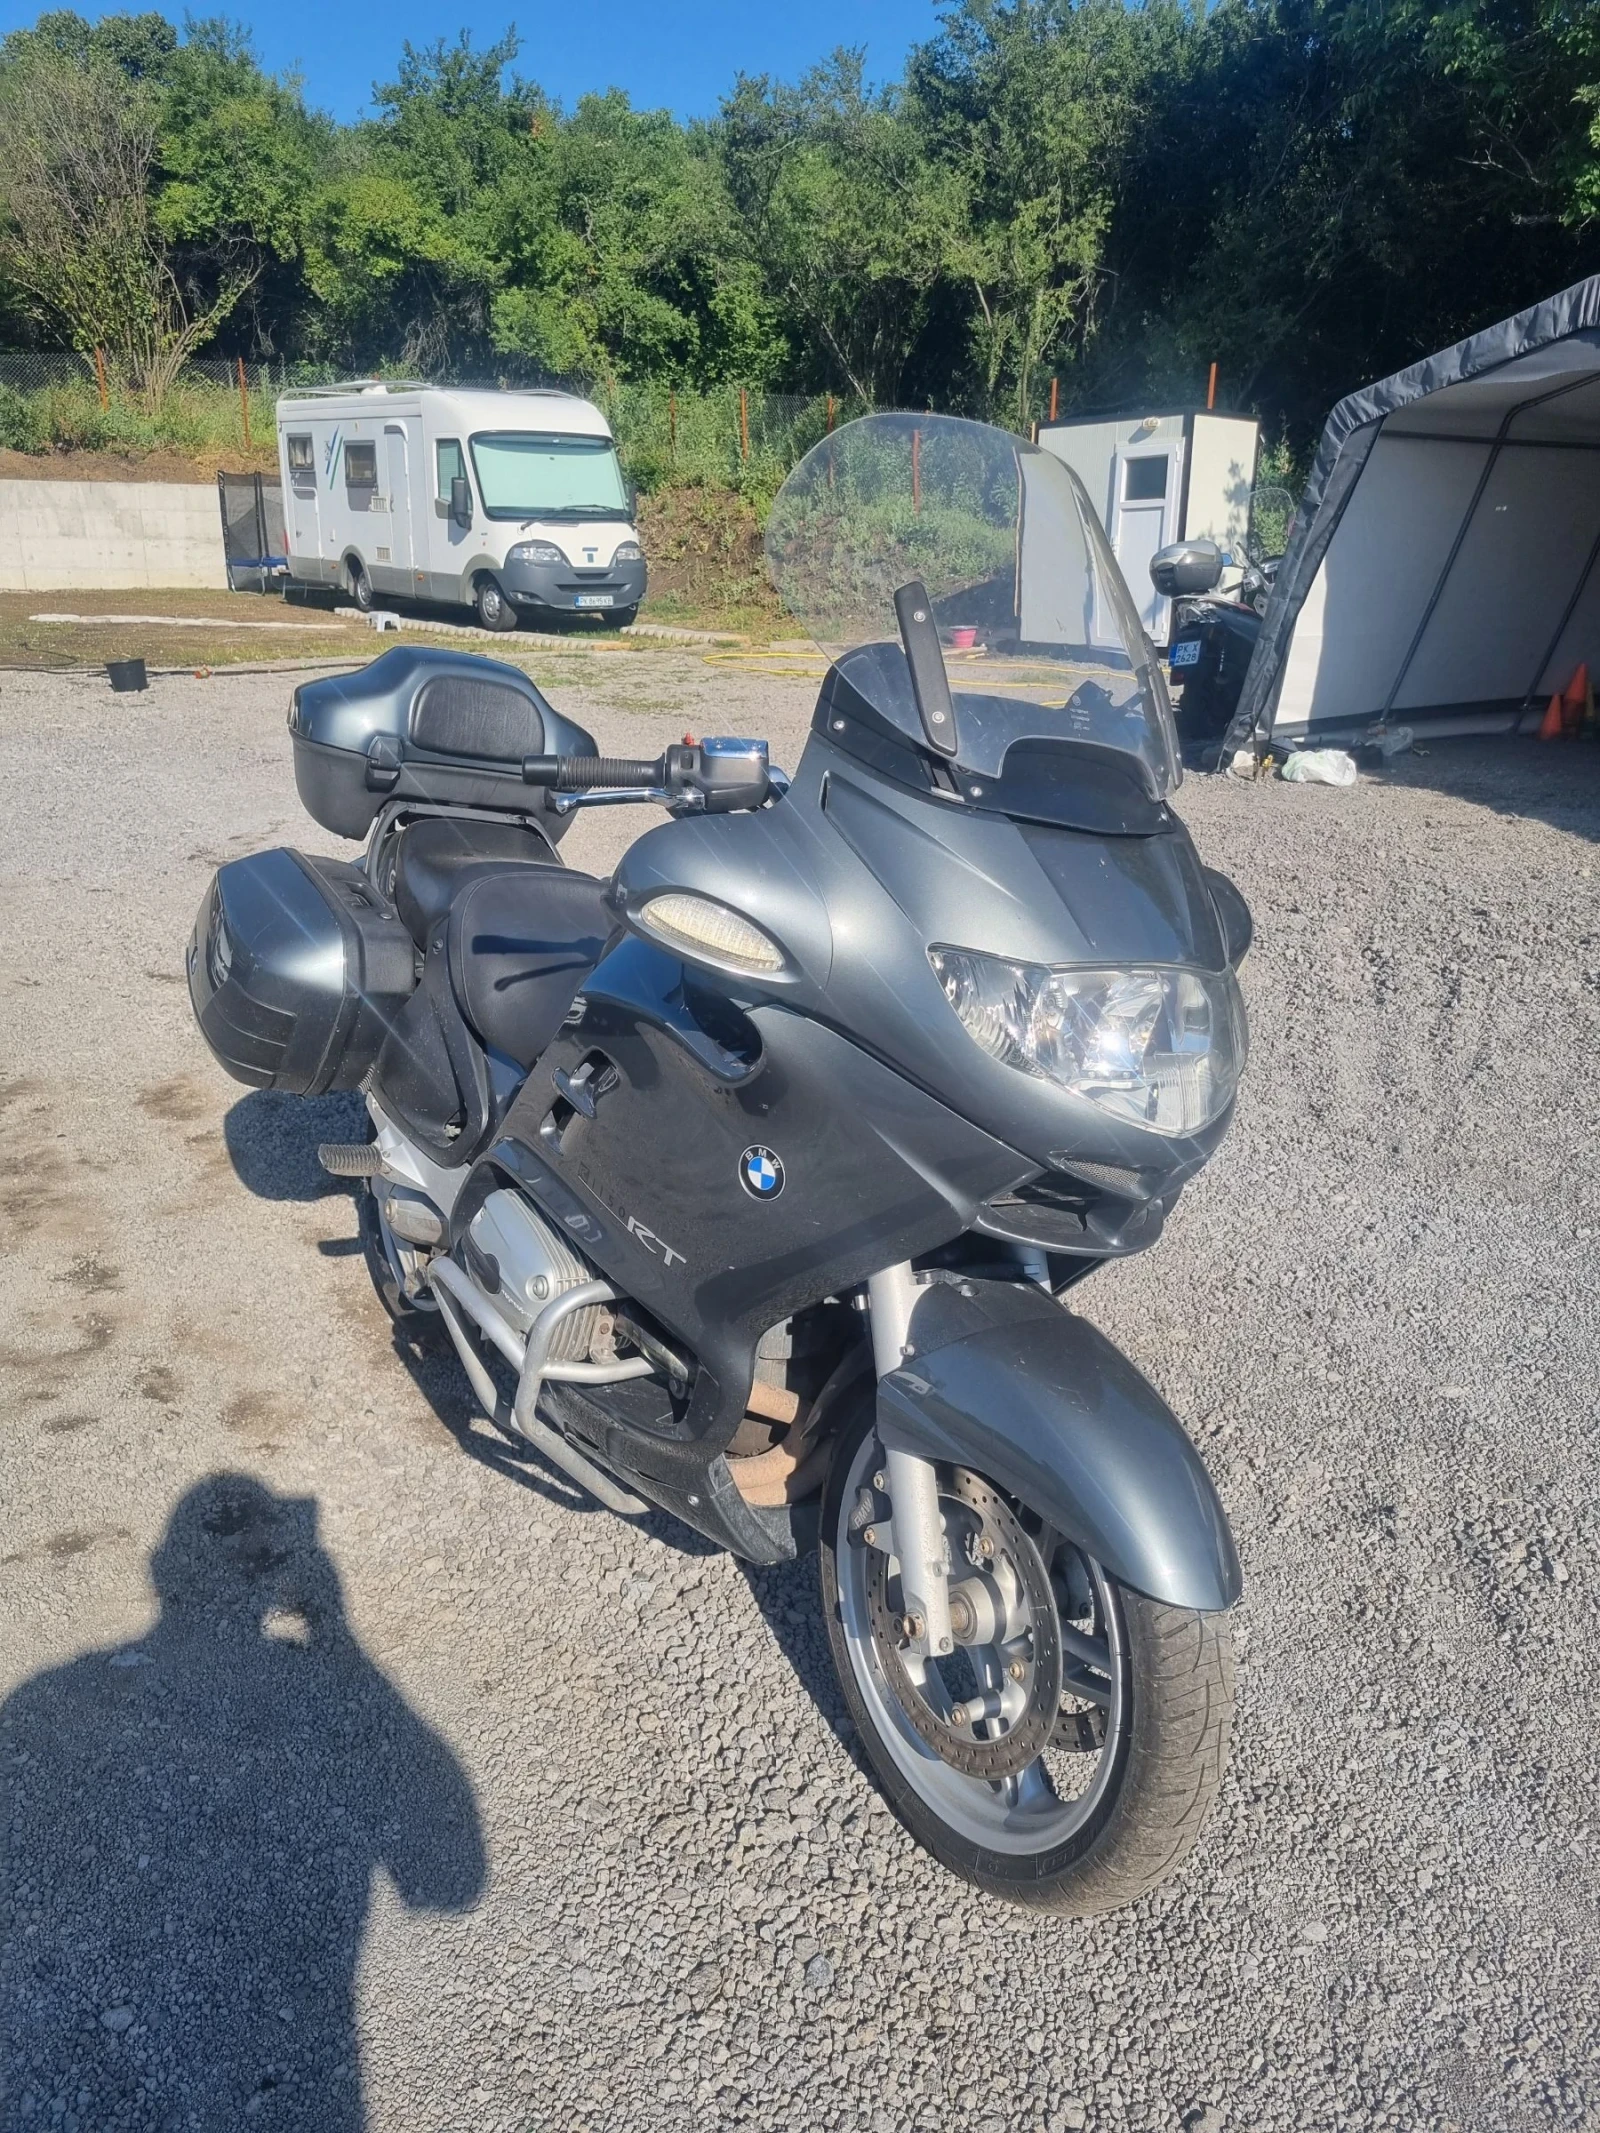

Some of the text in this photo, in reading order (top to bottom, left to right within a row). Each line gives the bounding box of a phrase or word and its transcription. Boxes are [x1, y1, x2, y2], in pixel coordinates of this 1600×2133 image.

[1176, 653, 1197, 663] 2628
[1178, 643, 1199, 653] PK X
[745, 1148, 781, 1170] BMW
[627, 1216, 687, 1267] RT
[853, 1497, 872, 1529] BMW
